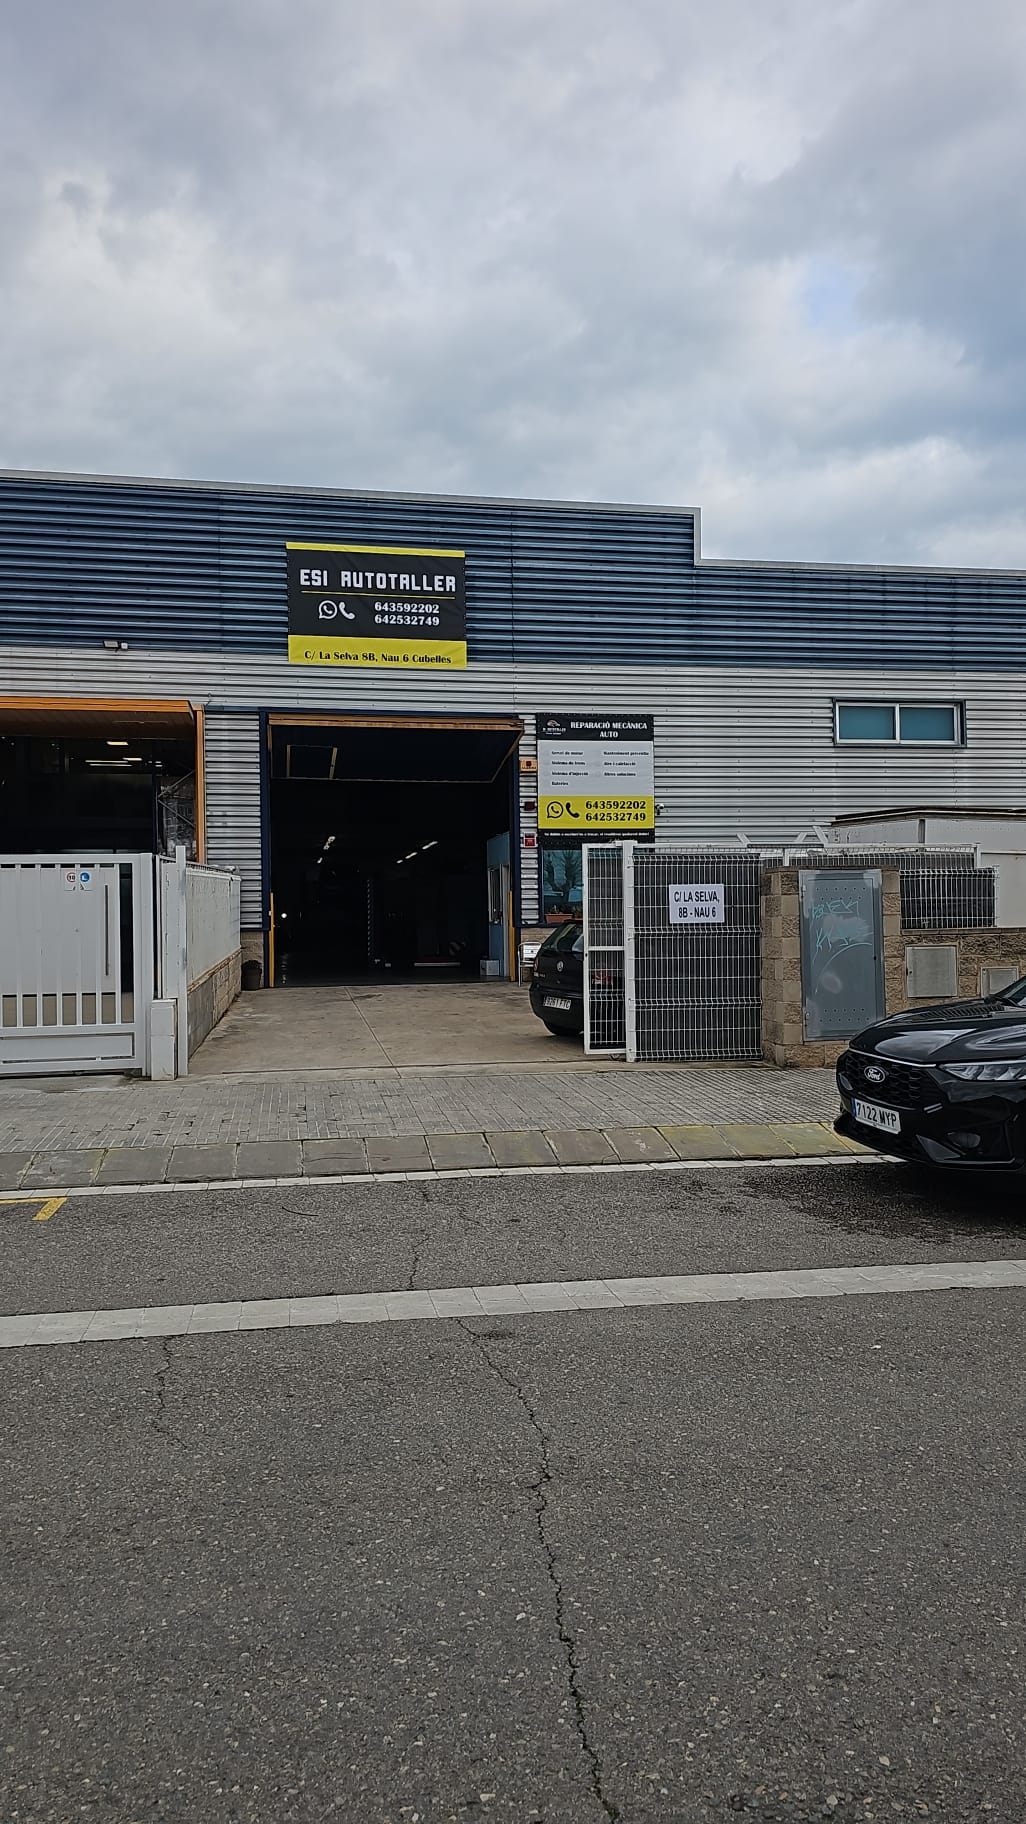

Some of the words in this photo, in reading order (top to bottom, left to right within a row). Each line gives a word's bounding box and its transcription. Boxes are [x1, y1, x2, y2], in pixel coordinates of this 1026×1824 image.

[300, 569, 328, 586] ESI
[341, 570, 456, 592] AUTOTALLER
[374, 602, 440, 614] 643592202
[374, 614, 440, 626] 642532749
[304, 651, 316, 659] C/
[319, 651, 331, 660] La
[334, 652, 359, 661] Selva
[362, 653, 378, 662] 8B,
[381, 653, 399, 662] Nau
[402, 654, 409, 663] 6
[412, 654, 452, 664] Cubelles
[585, 801, 646, 810] 643592202
[585, 812, 646, 821] 642532749
[674, 891, 682, 902] C/
[684, 891, 693, 902] LA
[694, 891, 720, 904] SELVA,
[678, 907, 688, 918] 8B
[694, 906, 710, 918] NAU
[712, 906, 716, 918] 6
[856, 1102, 878, 1122] 7122
